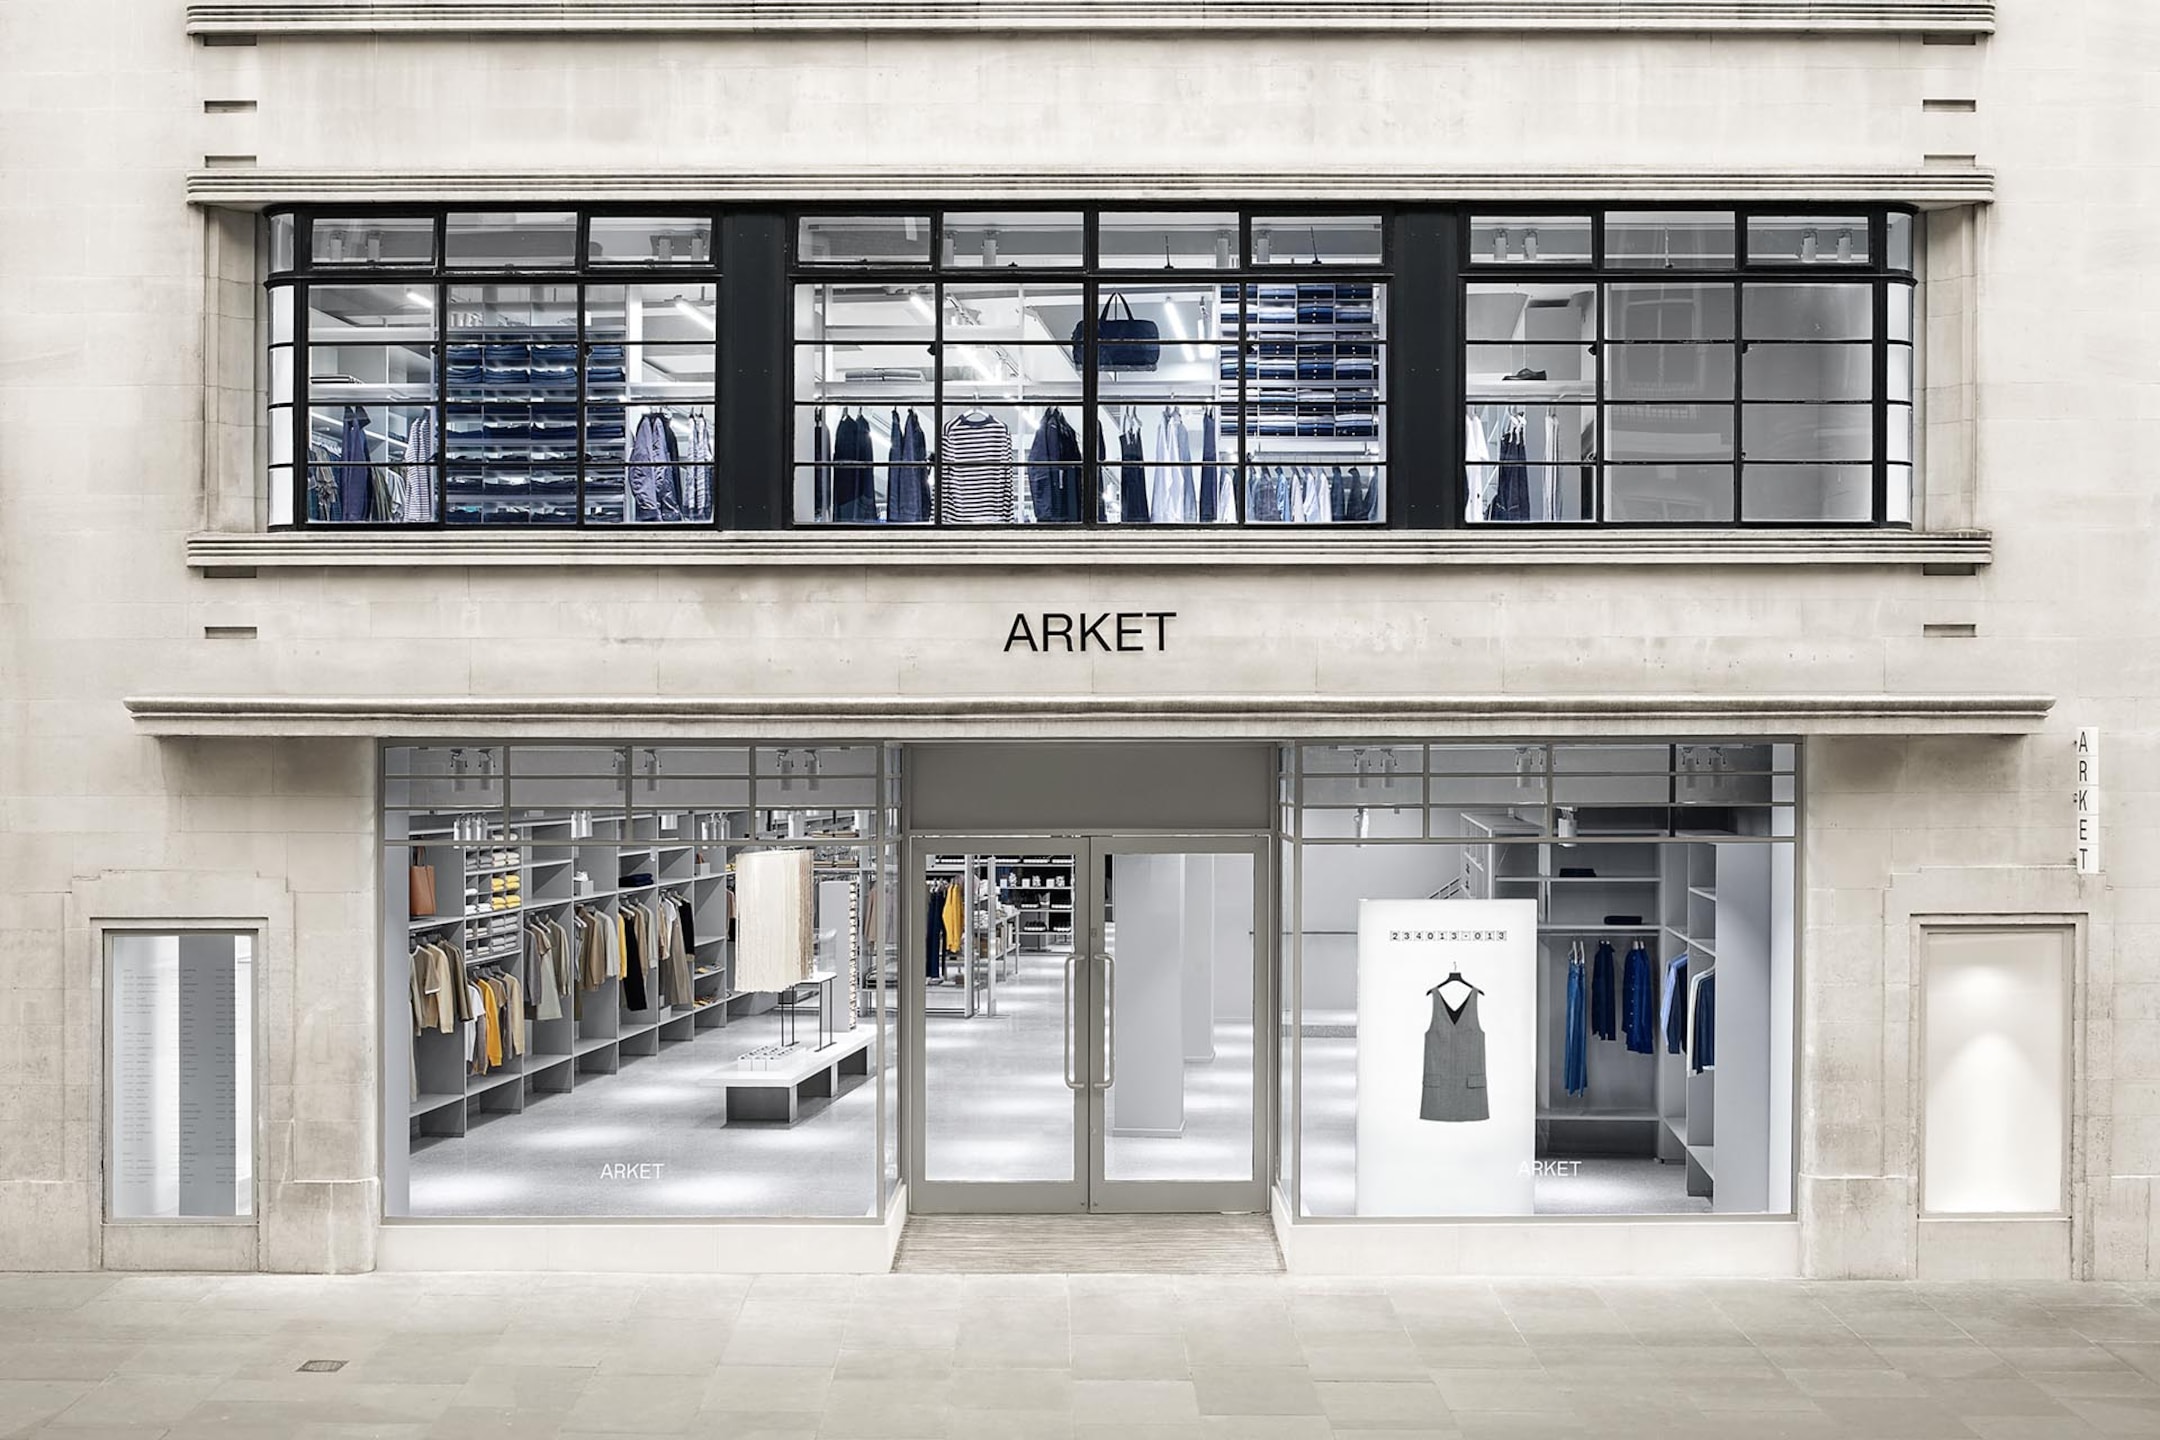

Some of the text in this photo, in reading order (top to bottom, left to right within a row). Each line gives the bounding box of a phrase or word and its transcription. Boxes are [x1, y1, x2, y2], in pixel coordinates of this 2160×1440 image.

[1003, 612, 1177, 652] ARKET
[2078, 731, 2088, 870] ARKET
[1391, 931, 1506, 941] 234013-013
[600, 1163, 665, 1179] ARKET
[1516, 1160, 1582, 1177] ARKET
